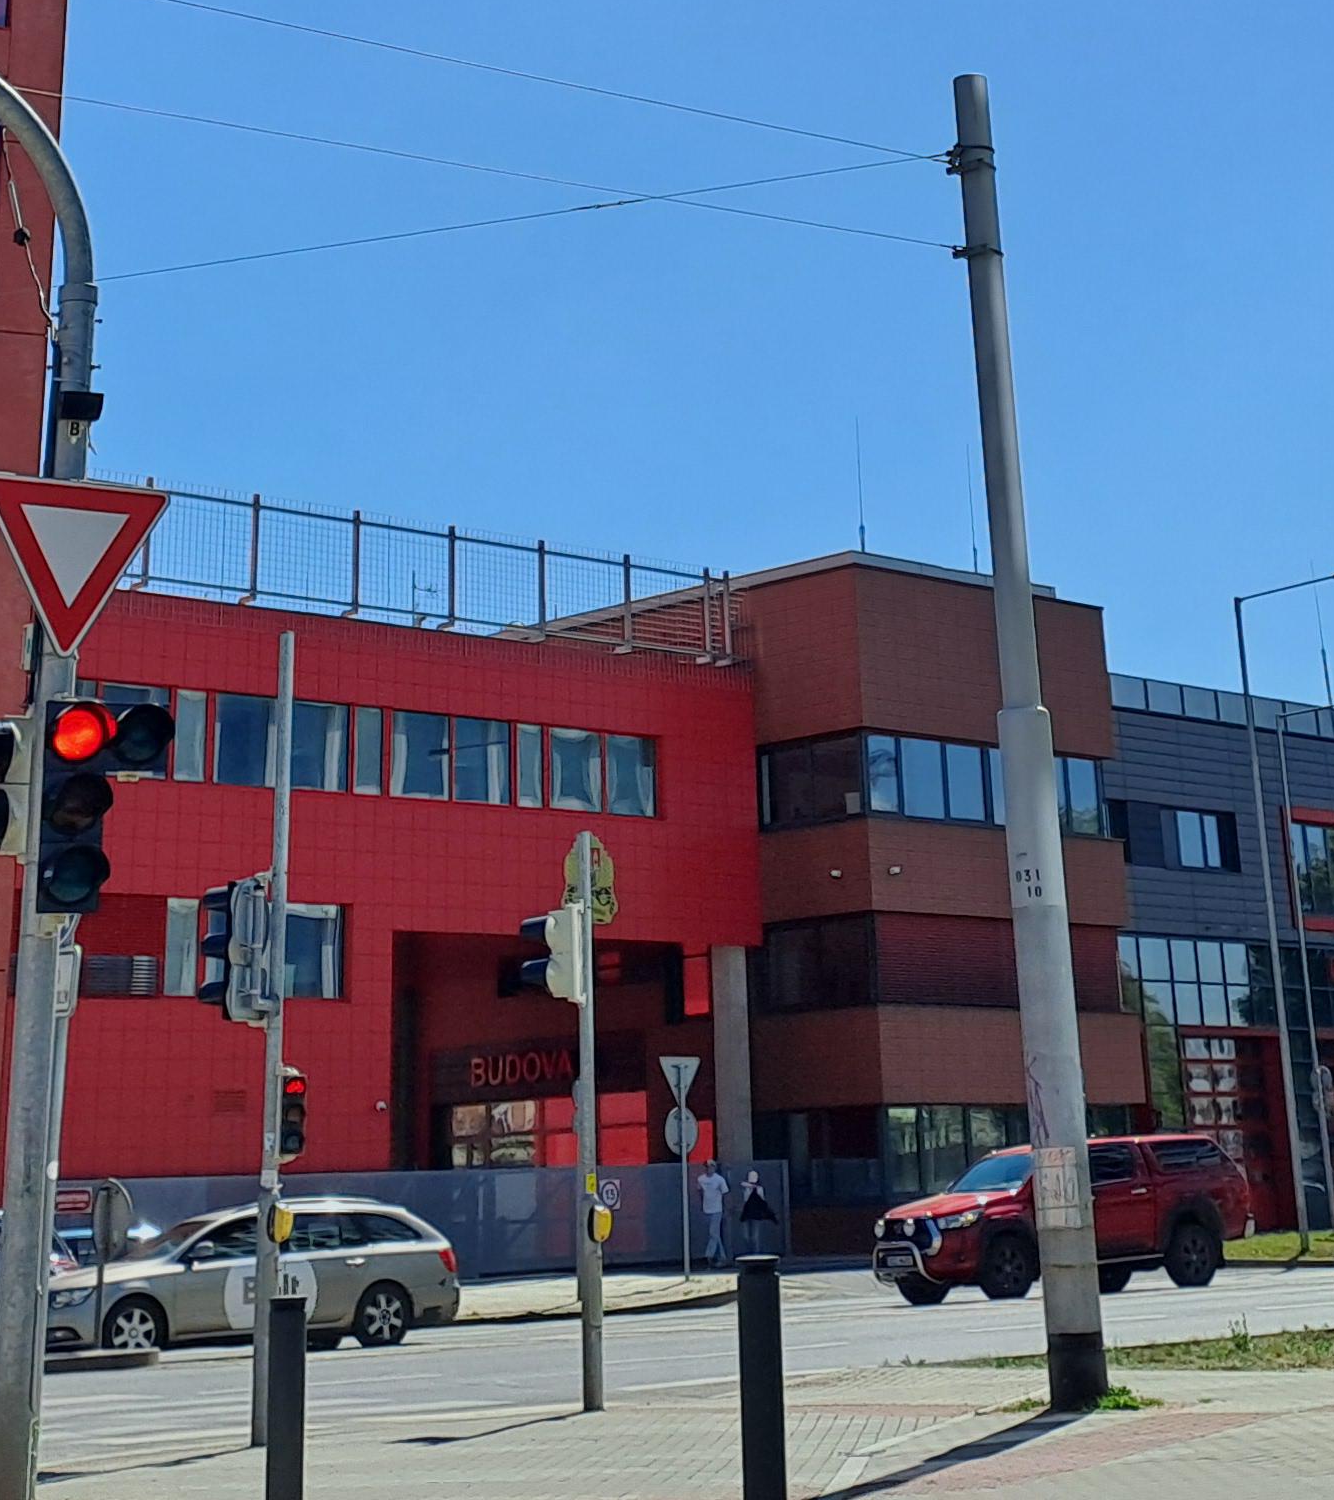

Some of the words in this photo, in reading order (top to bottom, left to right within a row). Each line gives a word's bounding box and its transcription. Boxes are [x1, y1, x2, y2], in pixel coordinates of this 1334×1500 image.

[70, 421, 80, 436] B
[1015, 868, 1040, 883] 031
[1027, 885, 1042, 898] 10
[470, 1050, 574, 1089] BUDOVA
